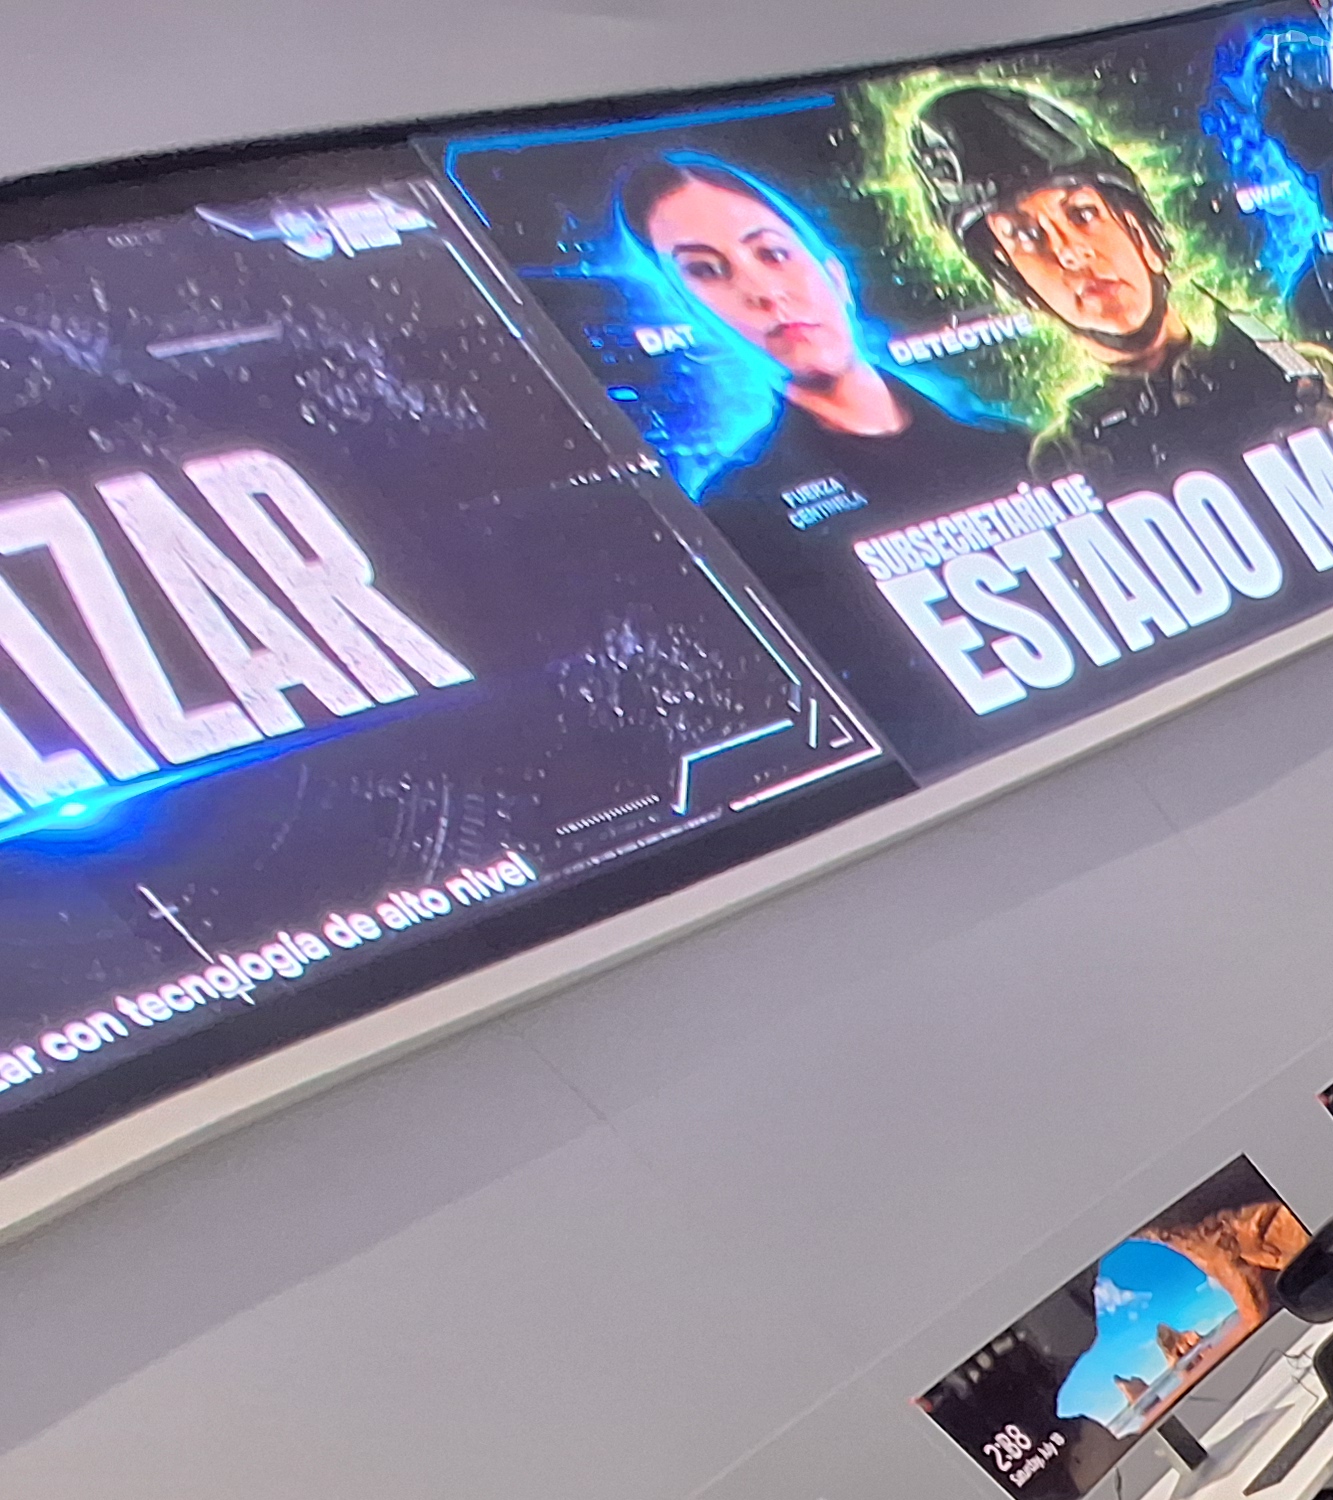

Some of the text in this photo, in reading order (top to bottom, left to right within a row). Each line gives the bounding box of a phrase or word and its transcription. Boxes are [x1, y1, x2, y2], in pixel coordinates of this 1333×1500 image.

[1235, 180, 1290, 212] SWAT
[887, 313, 1032, 366] DETECTIVE
[781, 476, 844, 508] FUERZA
[855, 475, 1103, 582] SUBSECRETARÍA DE
[876, 471, 1284, 716] ESTADO
[0, 1045, 42, 1092] ar
[40, 1010, 128, 1061] con
[324, 912, 382, 950] de
[377, 892, 451, 932] alto
[446, 851, 537, 906] nivel
